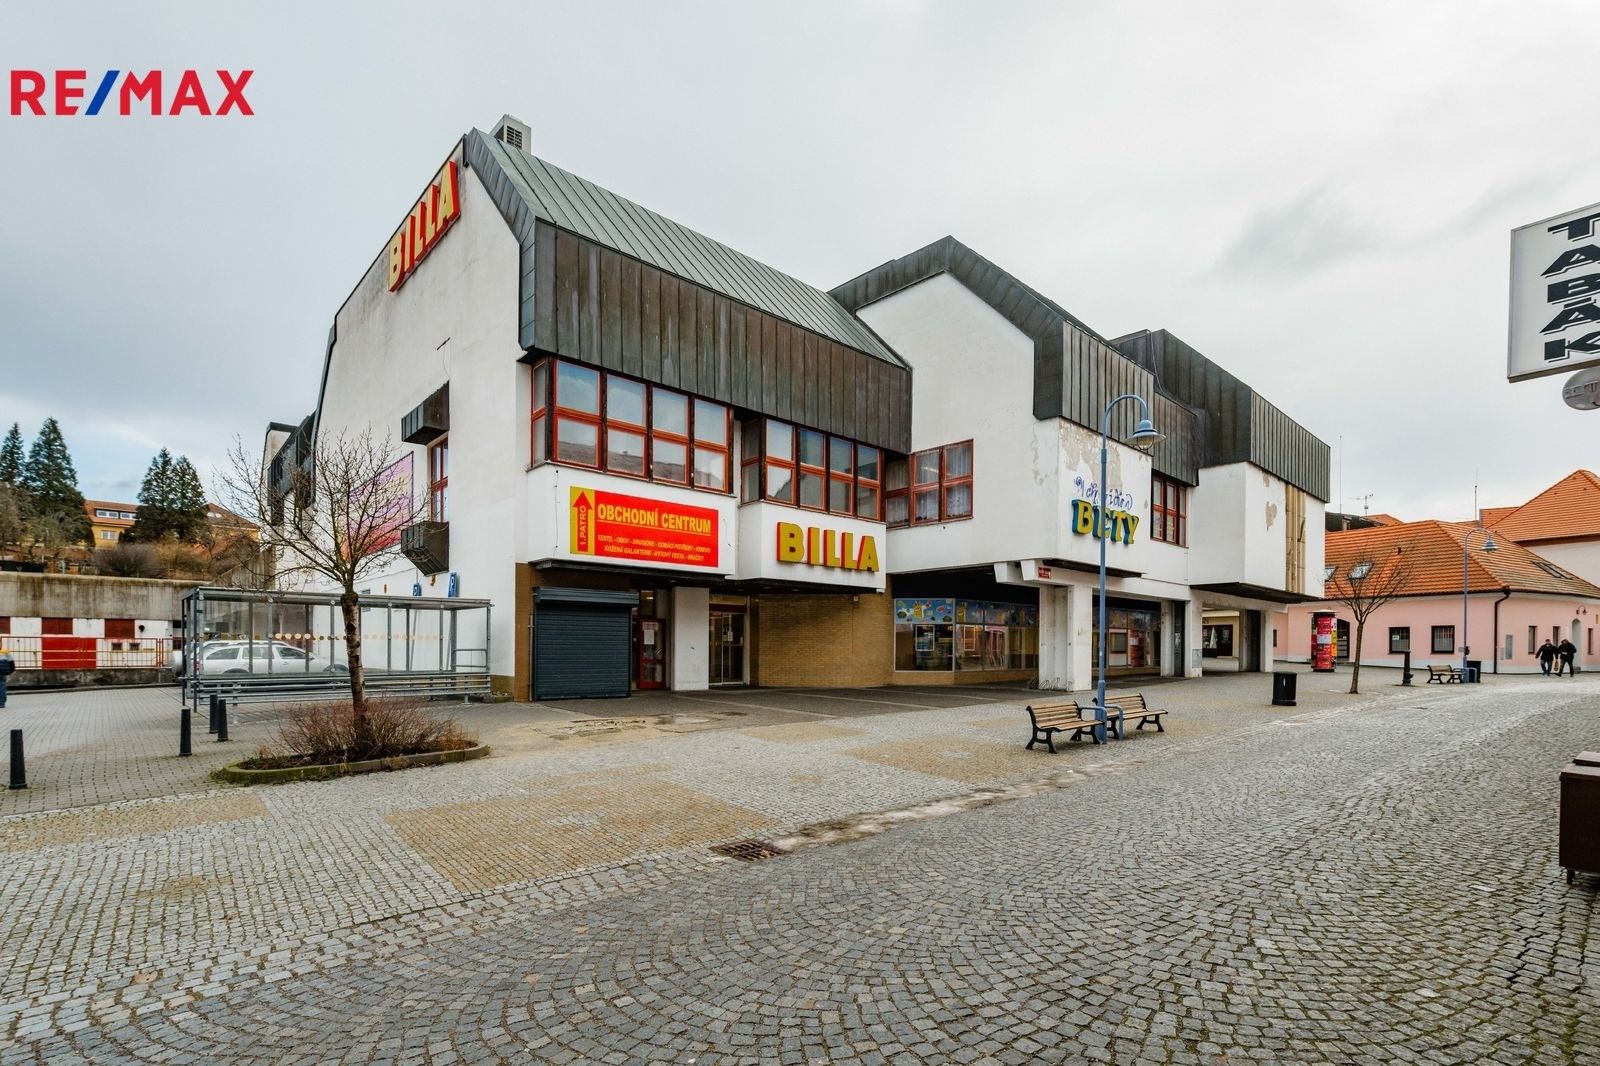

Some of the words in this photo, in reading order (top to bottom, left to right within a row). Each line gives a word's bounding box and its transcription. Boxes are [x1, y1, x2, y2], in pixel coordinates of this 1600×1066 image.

[388, 160, 461, 292] BILLA
[597, 504, 659, 526] OBCHODNÍ
[661, 513, 711, 534] CENTRUM
[776, 521, 879, 572] BILLA
